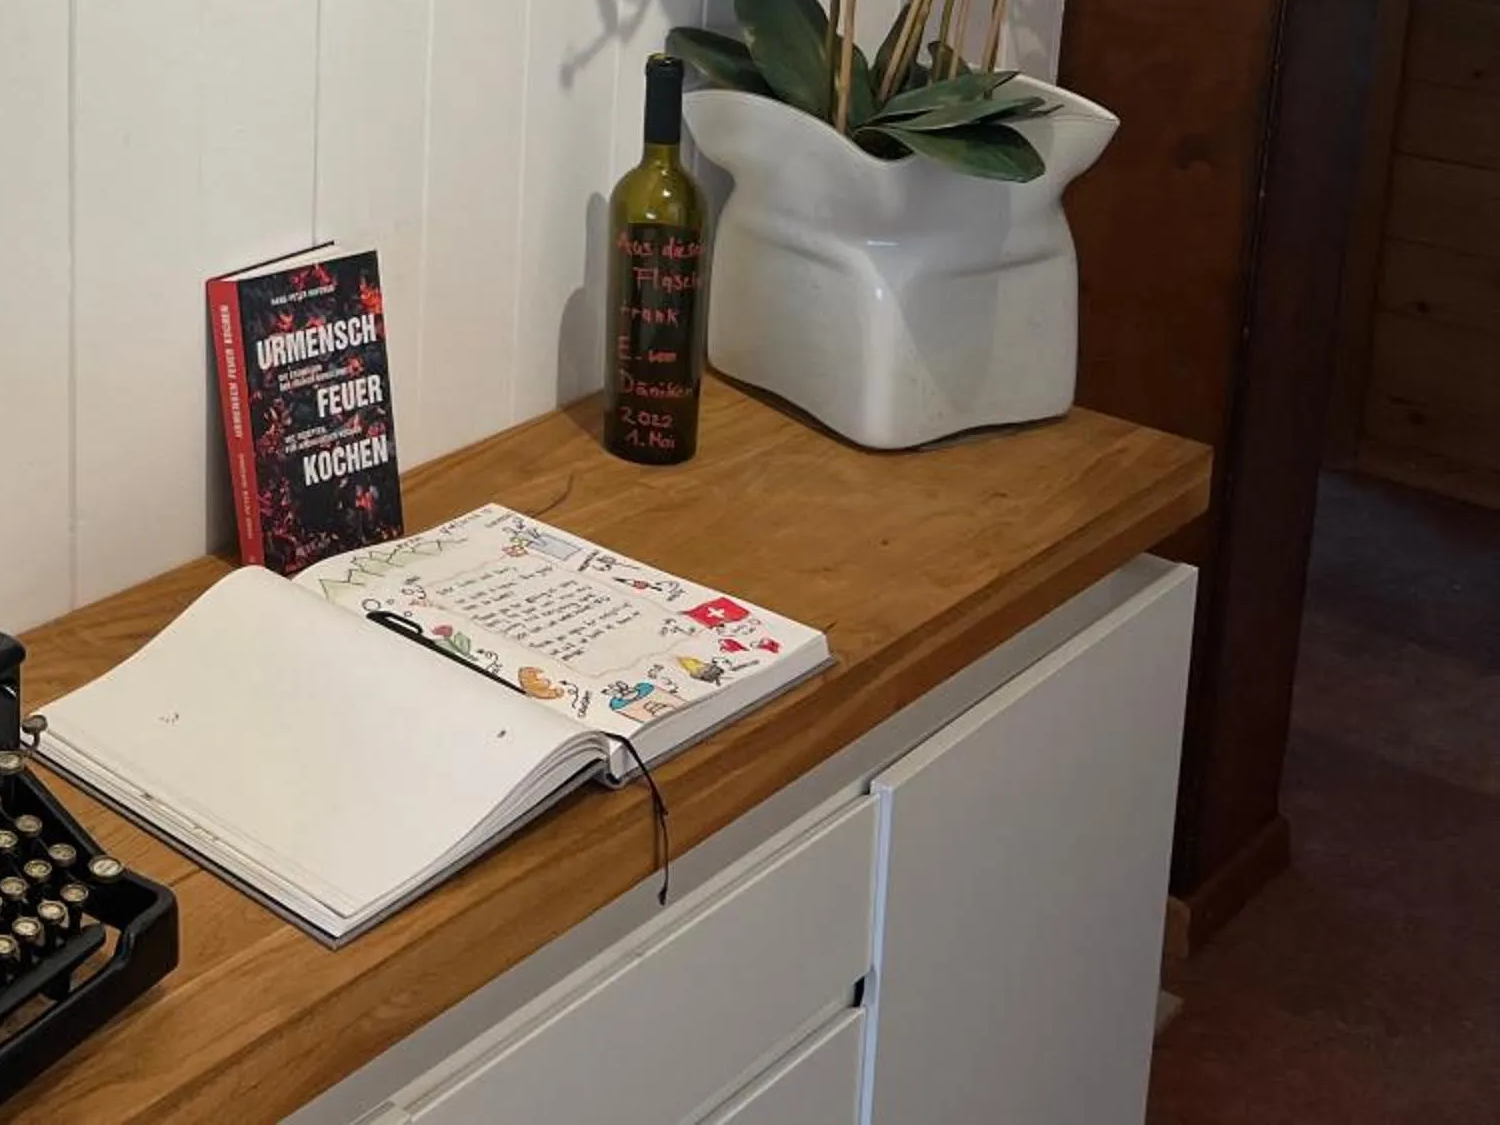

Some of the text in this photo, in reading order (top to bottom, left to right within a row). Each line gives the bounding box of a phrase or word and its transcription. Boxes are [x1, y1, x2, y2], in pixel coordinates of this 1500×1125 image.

[256, 314, 377, 371] URMENSCH
[317, 374, 383, 418] FEUER
[303, 434, 389, 486] KOCHEN
